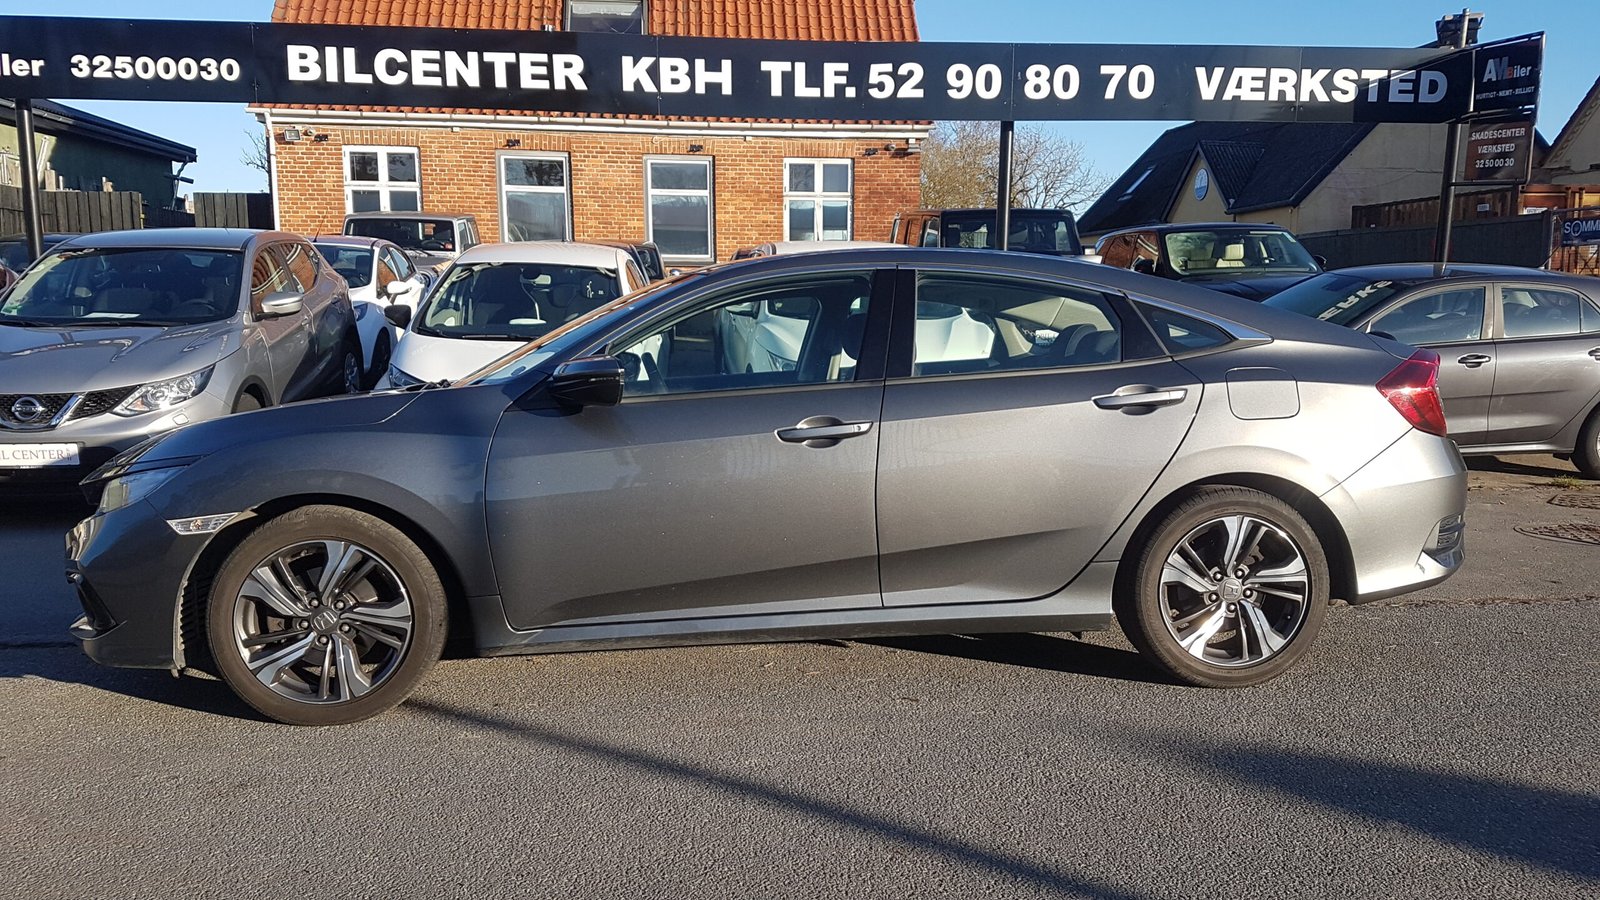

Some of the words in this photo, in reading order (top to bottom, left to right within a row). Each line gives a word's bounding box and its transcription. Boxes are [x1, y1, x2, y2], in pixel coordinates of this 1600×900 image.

[70, 54, 241, 82] 32500030
[286, 44, 589, 91] BILCENTER
[621, 55, 733, 96] KBH
[760, 61, 857, 98] TLF.
[868, 62, 926, 99] 52
[946, 63, 1003, 100] 90
[1024, 64, 1081, 100] 80
[1099, 64, 1156, 100] 70
[1195, 66, 1448, 104] VÆRKSTED
[1471, 128, 1525, 140] SKADESCENTER
[1477, 143, 1516, 154] VÆRKSTED
[12, 449, 66, 460] CENTER
